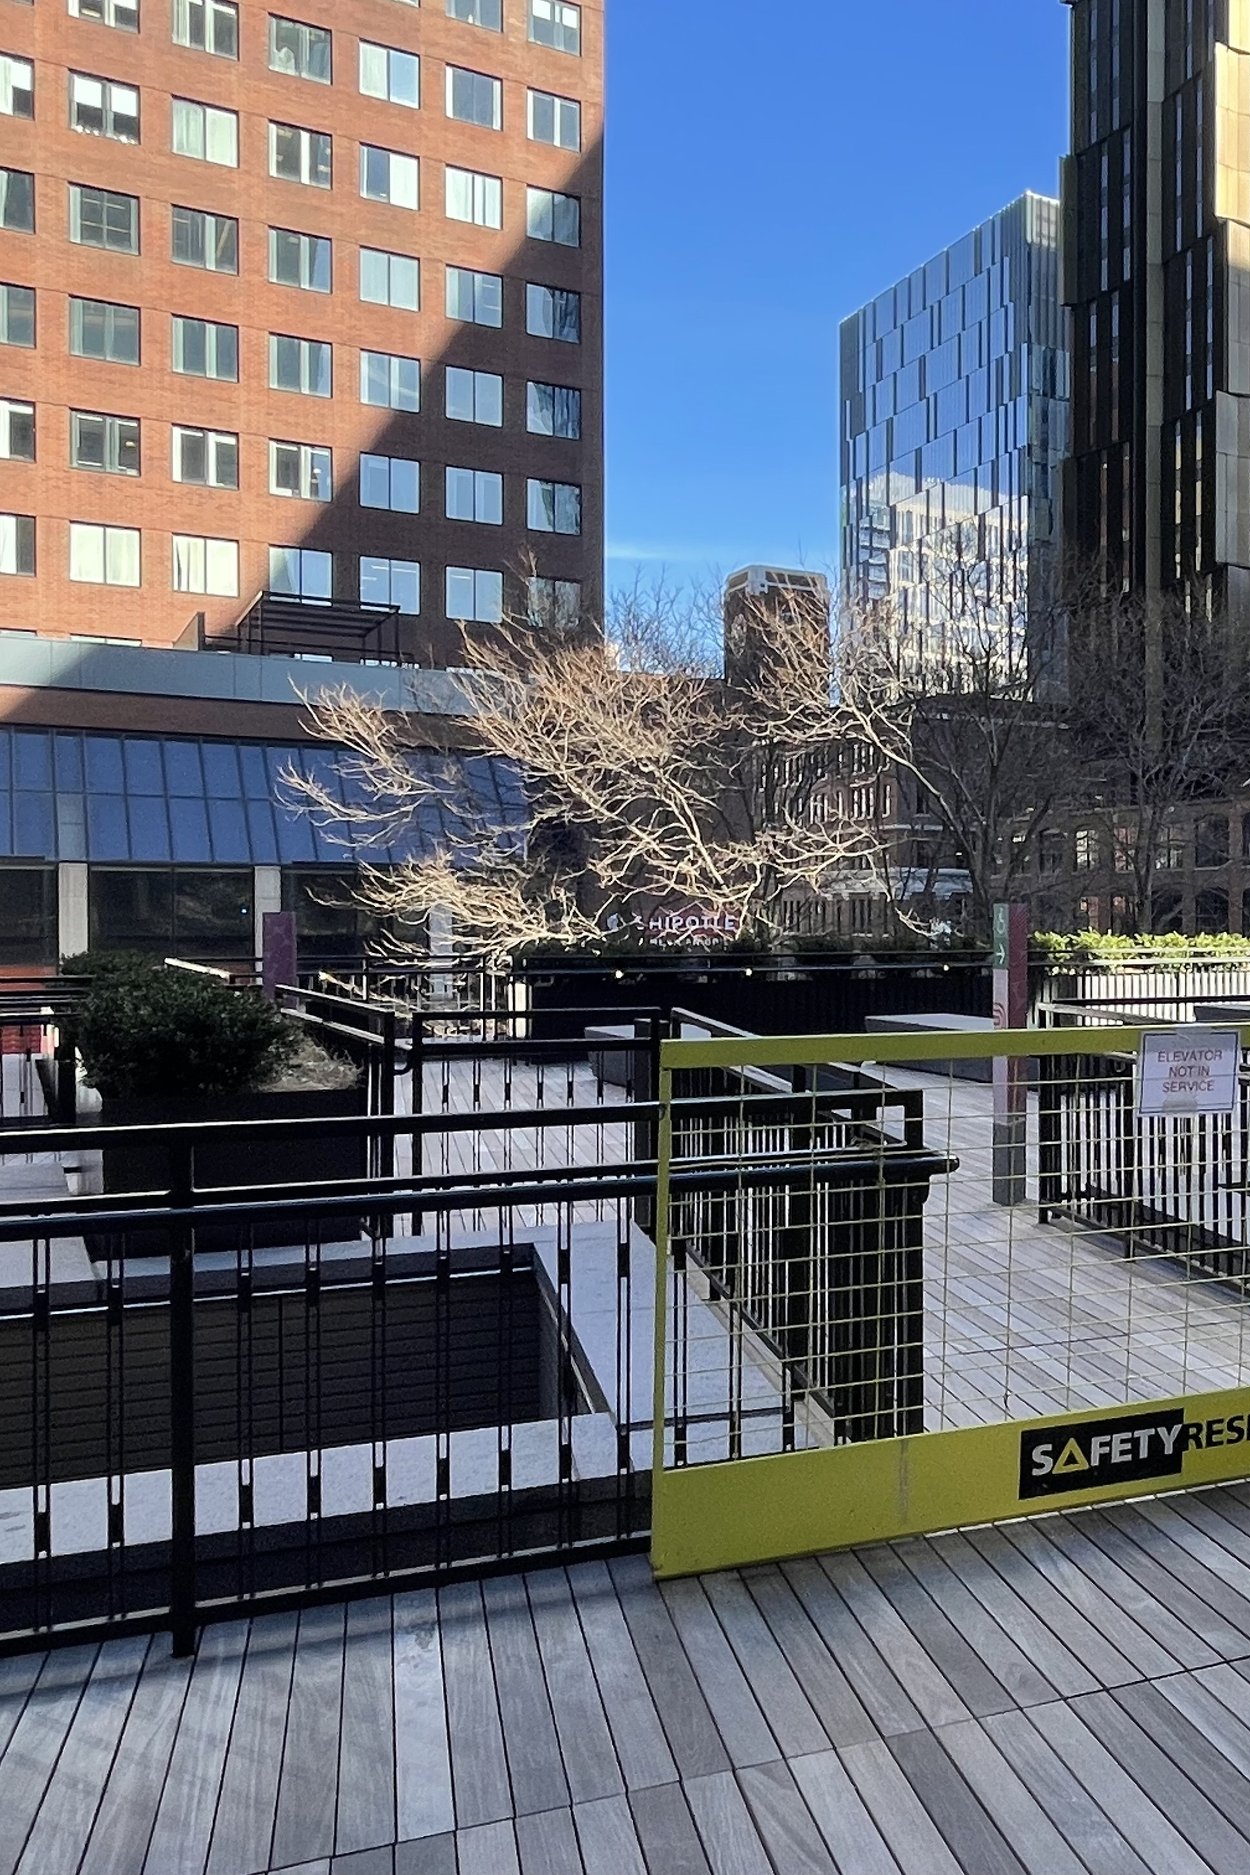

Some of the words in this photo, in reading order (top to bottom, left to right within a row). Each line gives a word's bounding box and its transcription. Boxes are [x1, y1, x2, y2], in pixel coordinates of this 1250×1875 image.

[1157, 1049, 1223, 1062] ELEVATOR
[1168, 1065, 1195, 1078] NOT
[1198, 1065, 1210, 1077] IN
[1162, 1080, 1215, 1093] SERVICE
